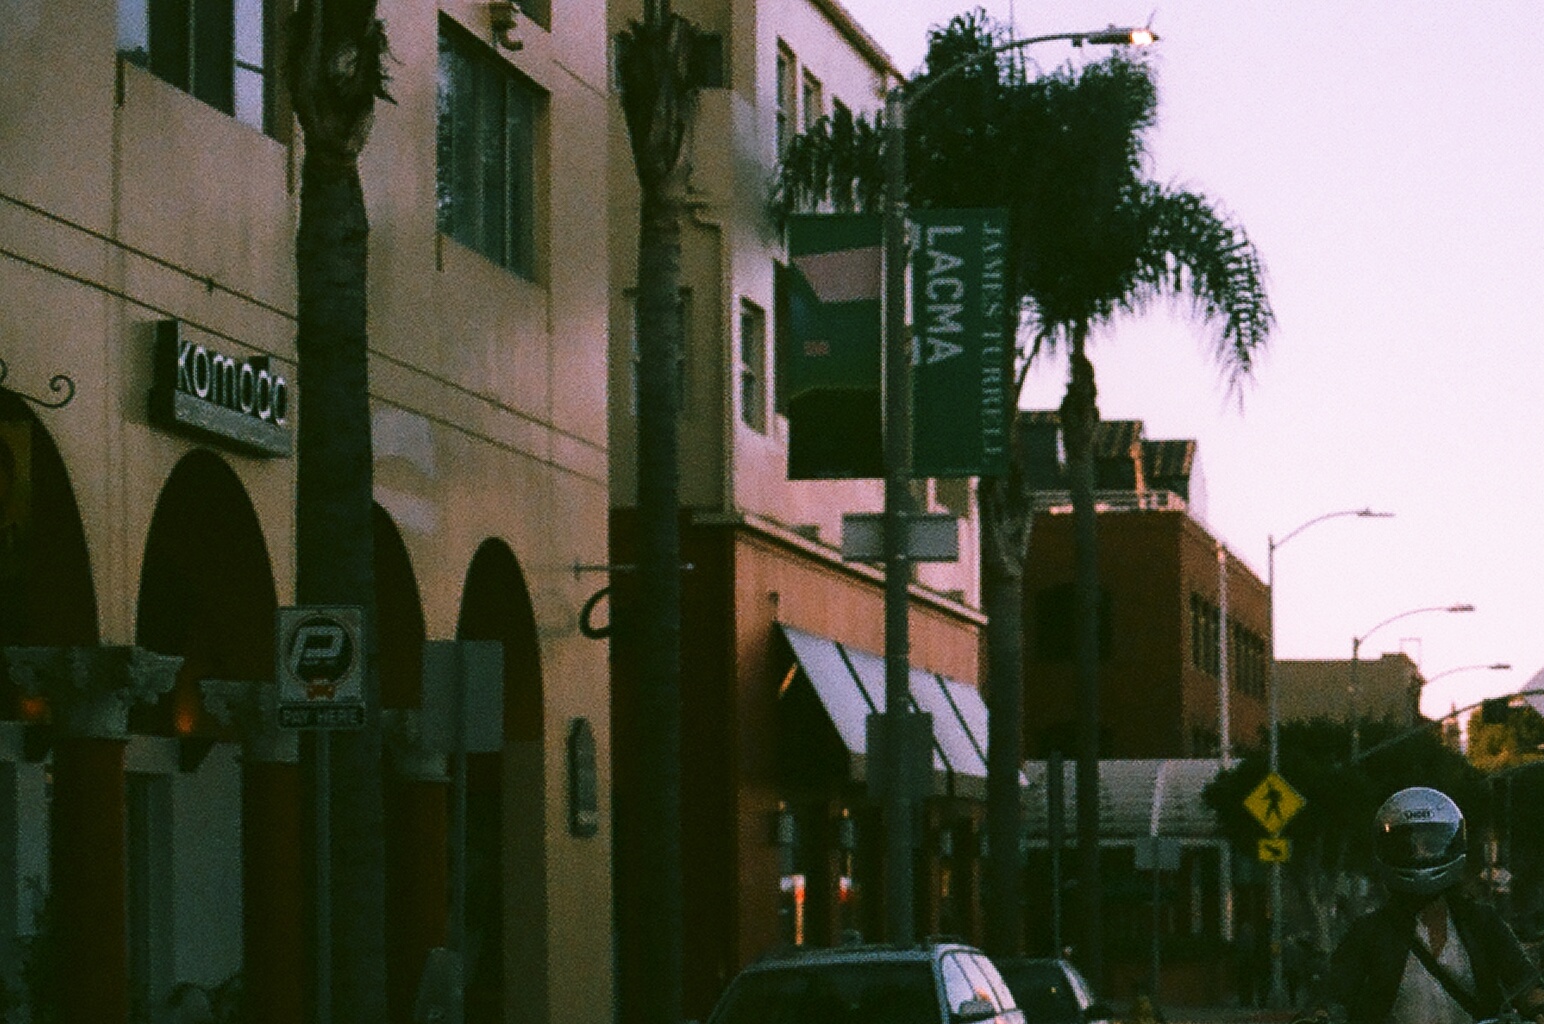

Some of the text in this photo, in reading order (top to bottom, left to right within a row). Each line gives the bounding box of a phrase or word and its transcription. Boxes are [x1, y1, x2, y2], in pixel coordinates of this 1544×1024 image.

[926, 225, 965, 364] LACMA
[981, 220, 1003, 318] JAMES
[178, 342, 288, 426] komodo
[283, 709, 358, 725] PAY HERE
